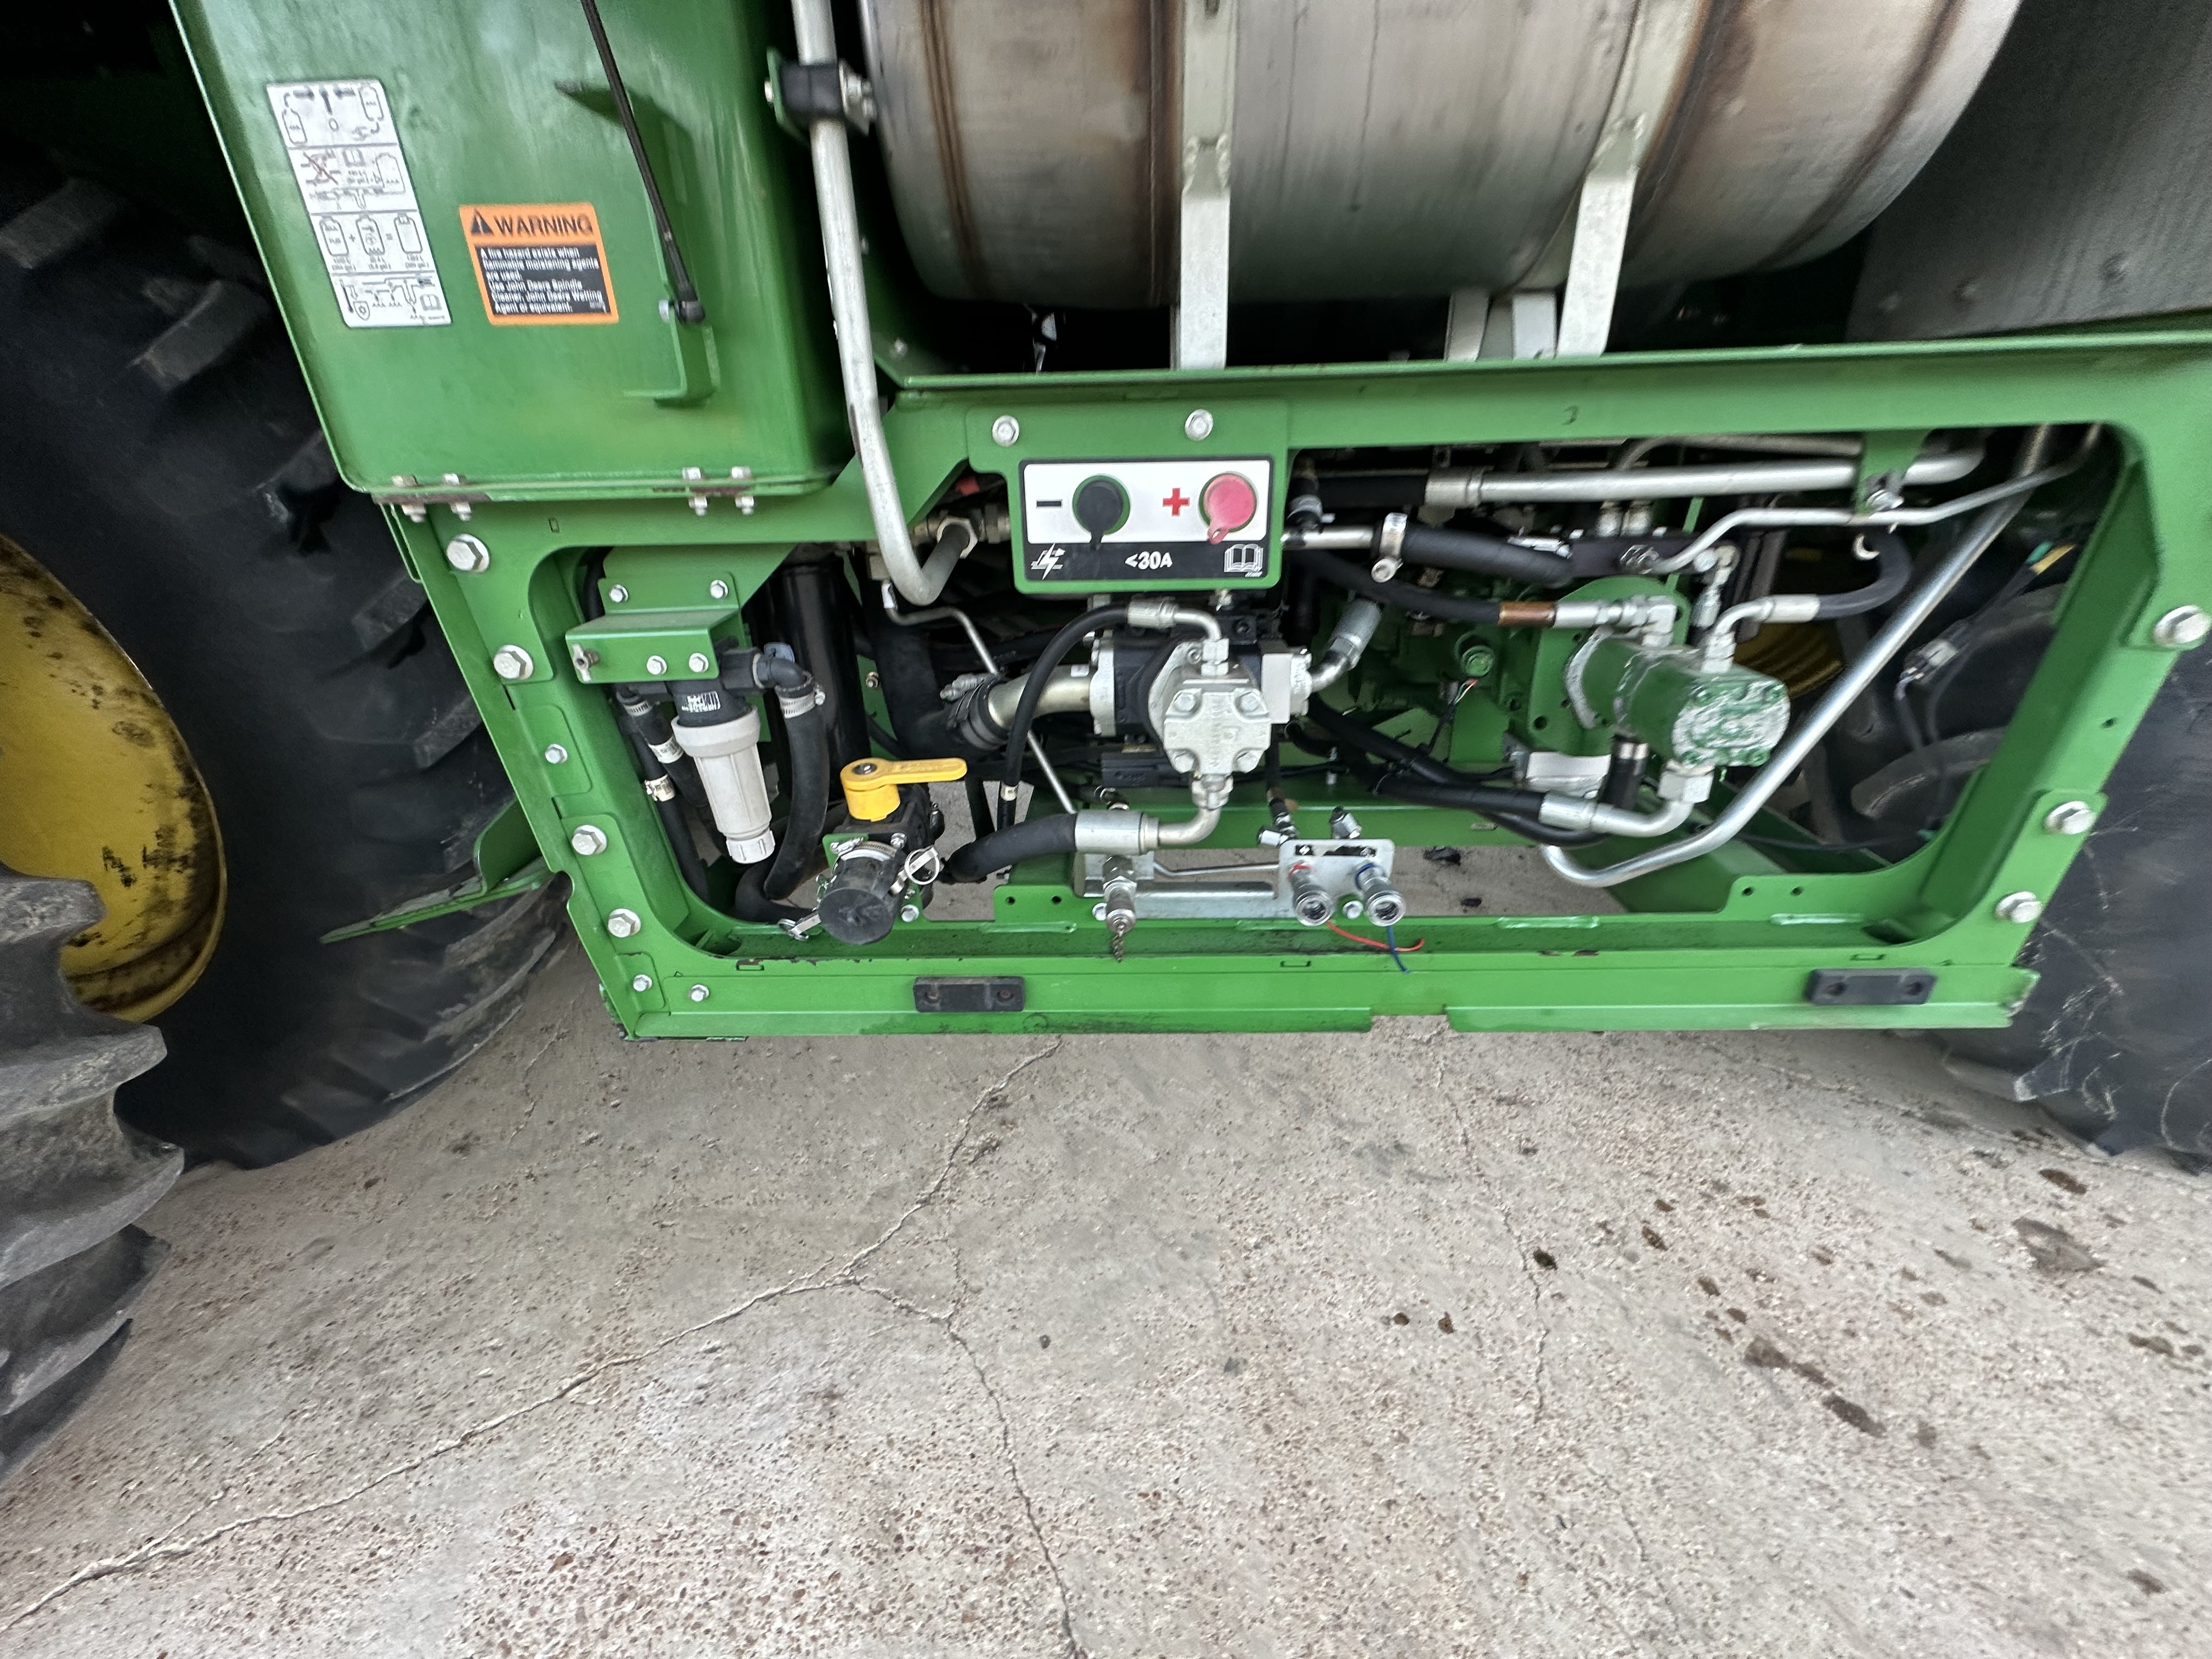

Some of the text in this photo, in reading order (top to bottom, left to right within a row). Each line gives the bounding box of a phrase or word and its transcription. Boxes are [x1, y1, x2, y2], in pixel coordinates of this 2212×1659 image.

[493, 213, 594, 237] WARNING
[481, 247, 580, 259] A fire hazard exists when
[526, 258, 571, 272] moistening
[571, 257, 599, 272] agents
[486, 271, 500, 281] are
[488, 279, 583, 292] Use John Deere Spindle
[526, 291, 546, 303] John
[547, 291, 571, 302] Deere
[571, 290, 603, 303] Wetting
[495, 302, 518, 314] Agent
[520, 303, 527, 313] or
[1125, 551, 1173, 569] <30A
